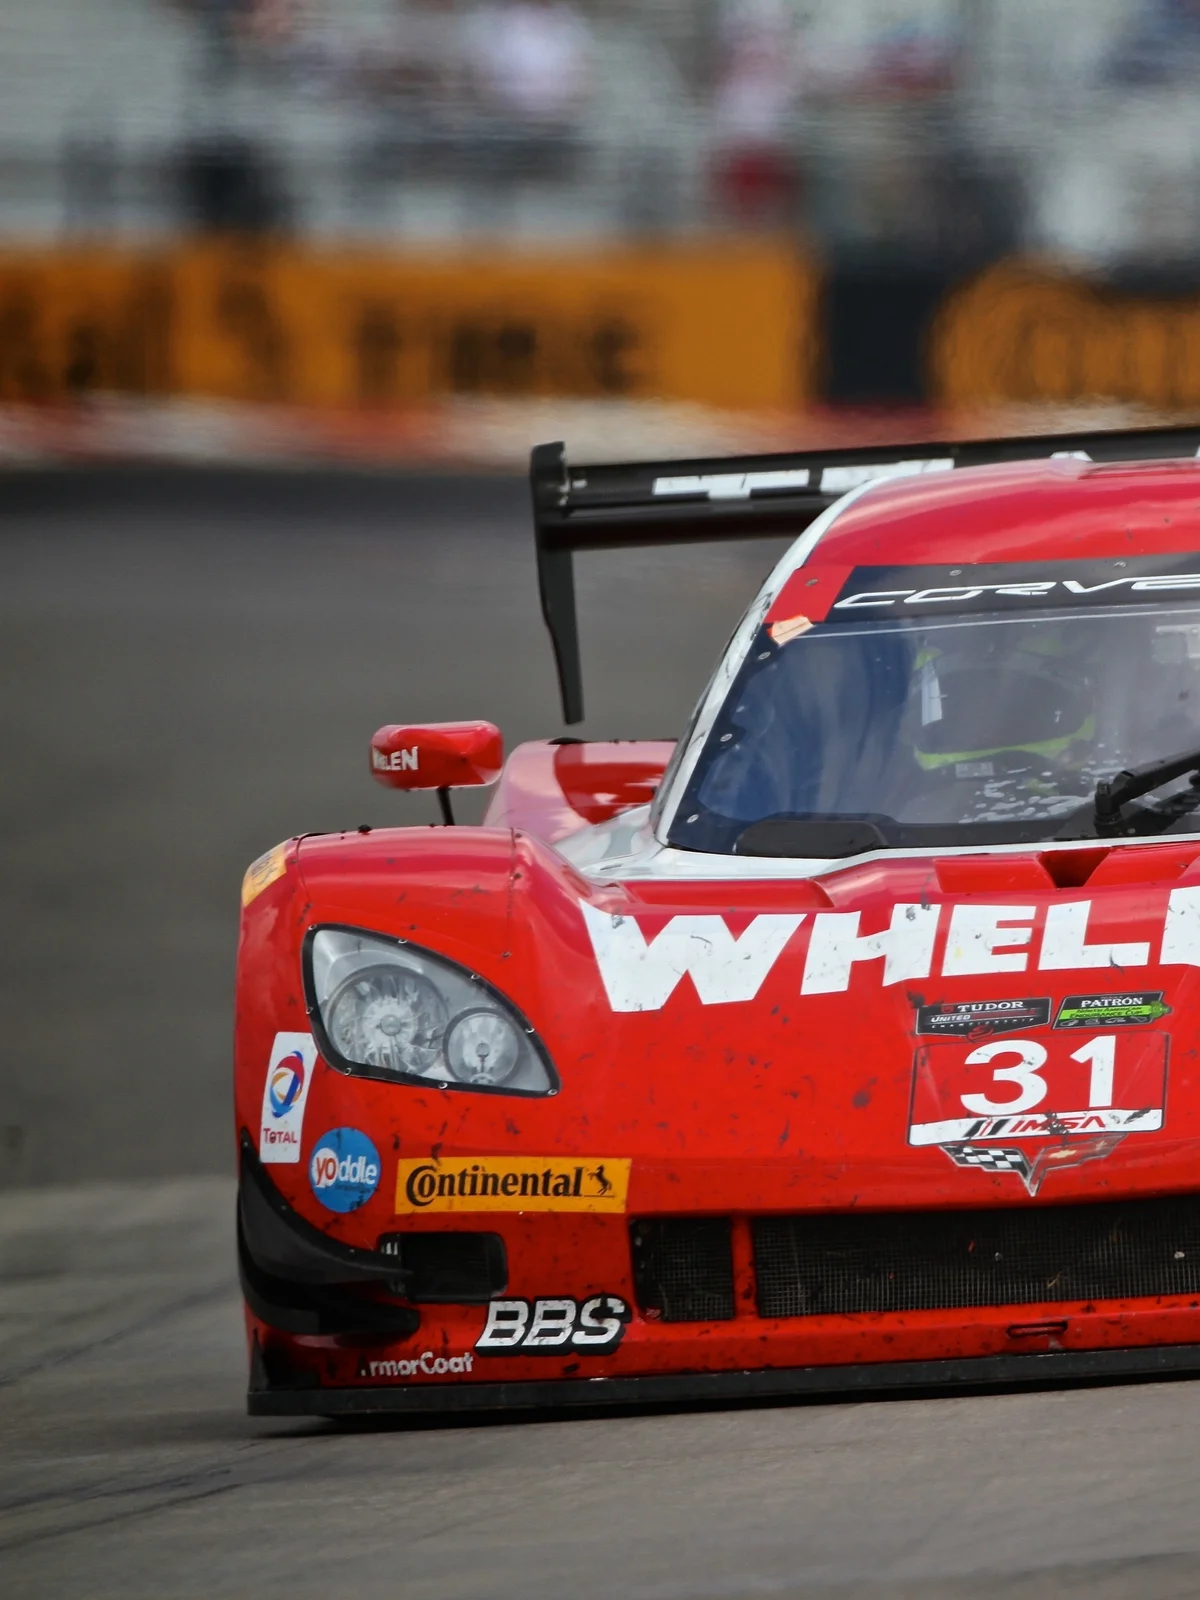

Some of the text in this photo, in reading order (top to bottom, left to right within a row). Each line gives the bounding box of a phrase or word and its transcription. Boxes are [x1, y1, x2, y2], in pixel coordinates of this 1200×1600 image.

[957, 1001, 1024, 1013] TUDOR
[1081, 996, 1143, 1008] PATRÓN
[930, 1014, 971, 1023] UNITED
[960, 1035, 1116, 1116] 31
[1009, 1116, 1106, 1134] IMSA
[316, 1154, 378, 1186] yoddle
[406, 1165, 585, 1207] Continental
[475, 1298, 626, 1348] BBS
